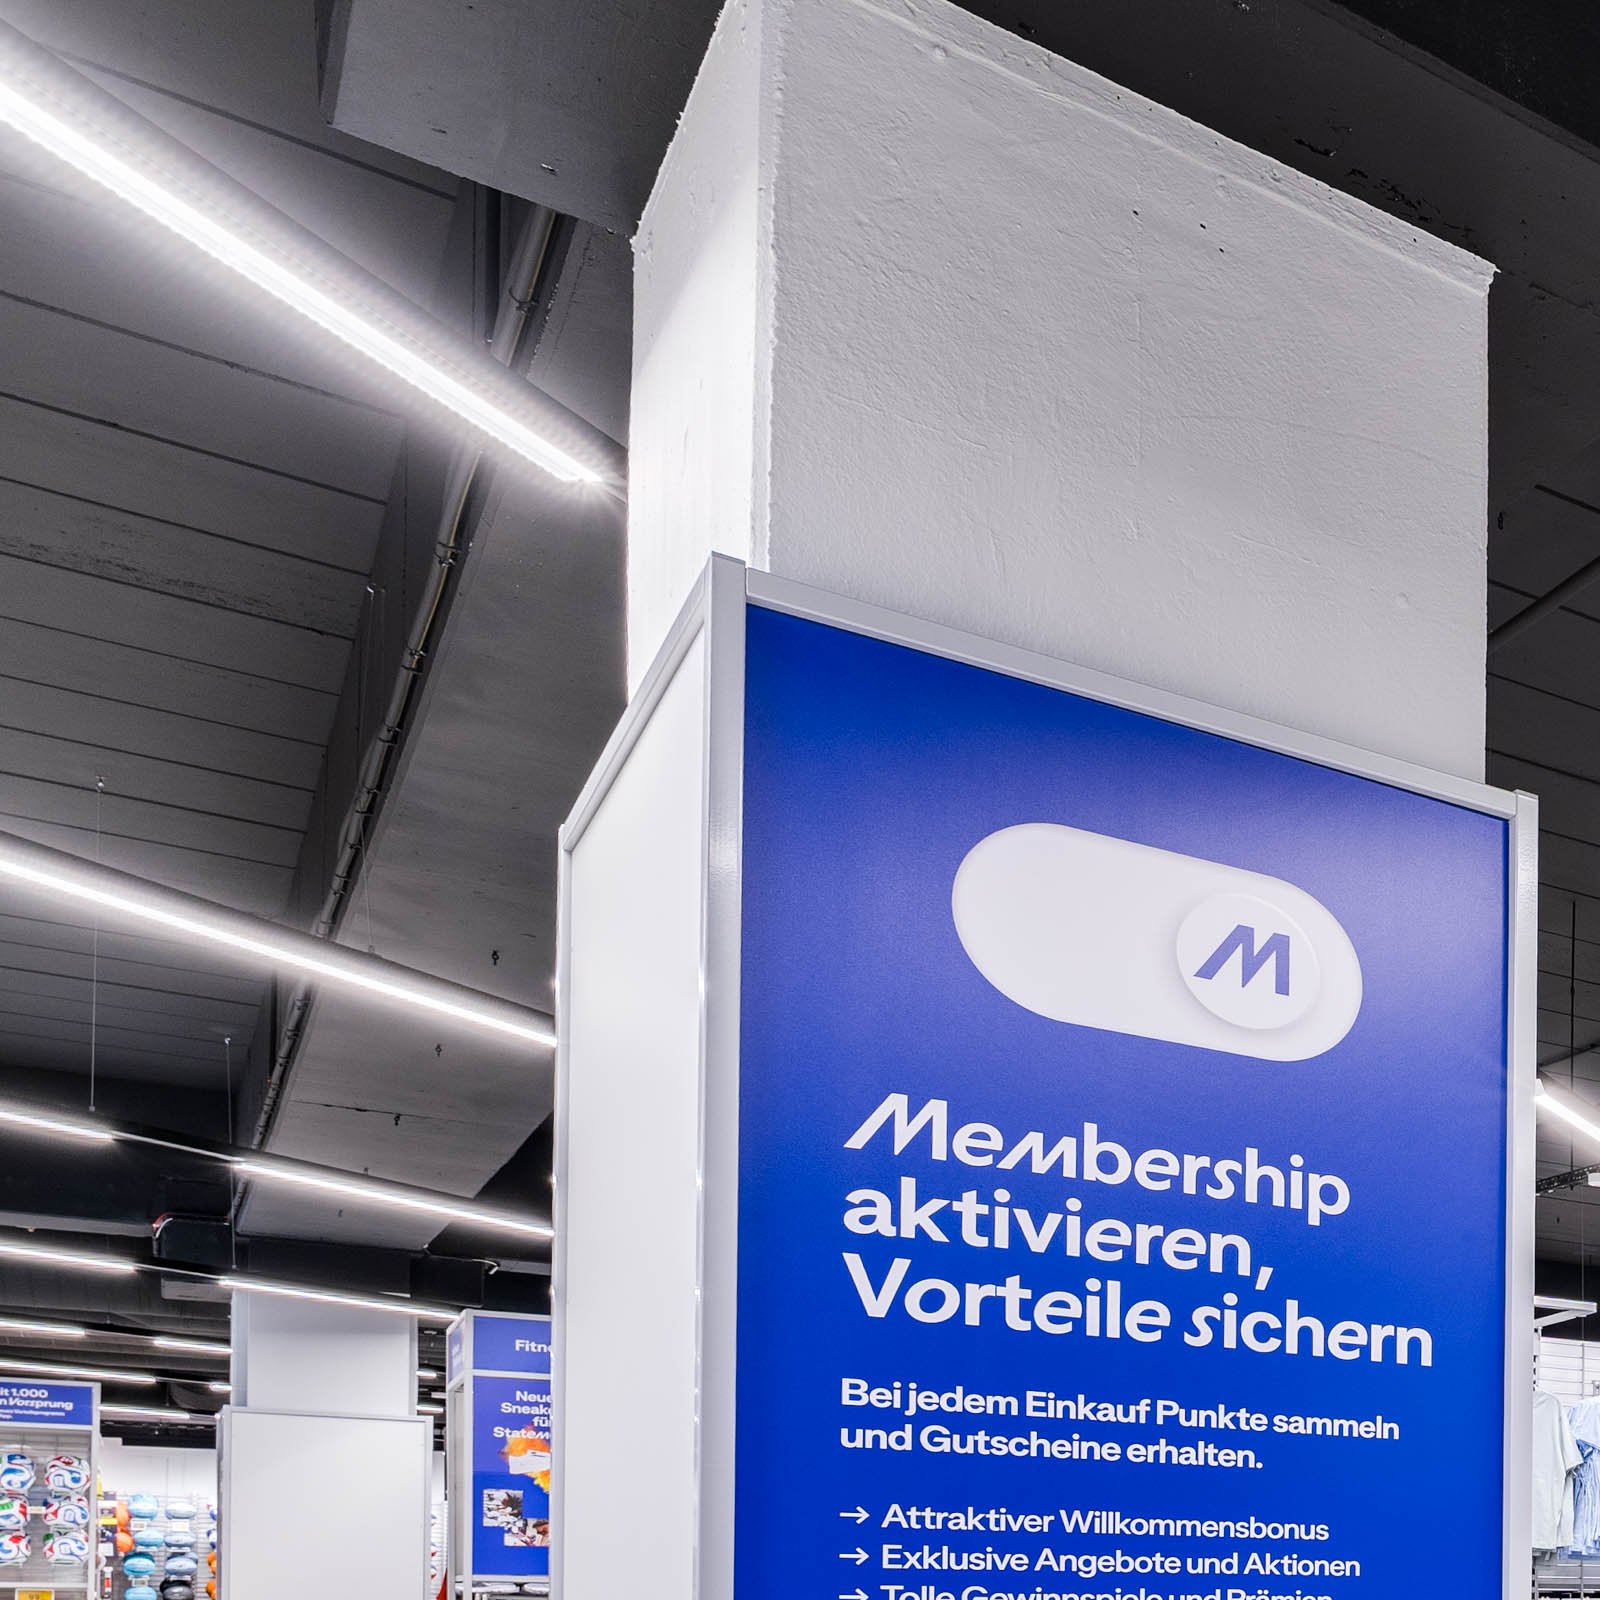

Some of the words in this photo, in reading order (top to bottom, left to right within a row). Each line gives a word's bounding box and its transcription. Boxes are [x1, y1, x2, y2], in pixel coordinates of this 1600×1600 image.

[1194, 923, 1292, 997] M
[843, 1092, 1351, 1227] Membership
[843, 1175, 1274, 1291] aktivieren,
[841, 1252, 1171, 1343] Vorteile
[1183, 1292, 1433, 1367] sichern
[8, 1398, 74, 1411] Vorsprung
[11, 1388, 49, 1399] 1.000
[841, 1377, 902, 1406] Bei
[905, 1382, 1019, 1417] jedem
[1025, 1390, 1152, 1424] Einkauf
[1156, 1399, 1269, 1432] Punkte
[1272, 1414, 1400, 1441] sammeln
[840, 1423, 913, 1451] und
[919, 1424, 1122, 1463] Gutscheine
[1126, 1438, 1264, 1469] erhalten.
[880, 1503, 1056, 1534] Attraktiver
[1059, 1509, 1330, 1541] Willkommensbonus
[882, 1543, 1030, 1572] Exklusive
[1033, 1547, 1182, 1579] Angebote
[1186, 1551, 1239, 1575] und
[1243, 1552, 1361, 1577] Aktionen
